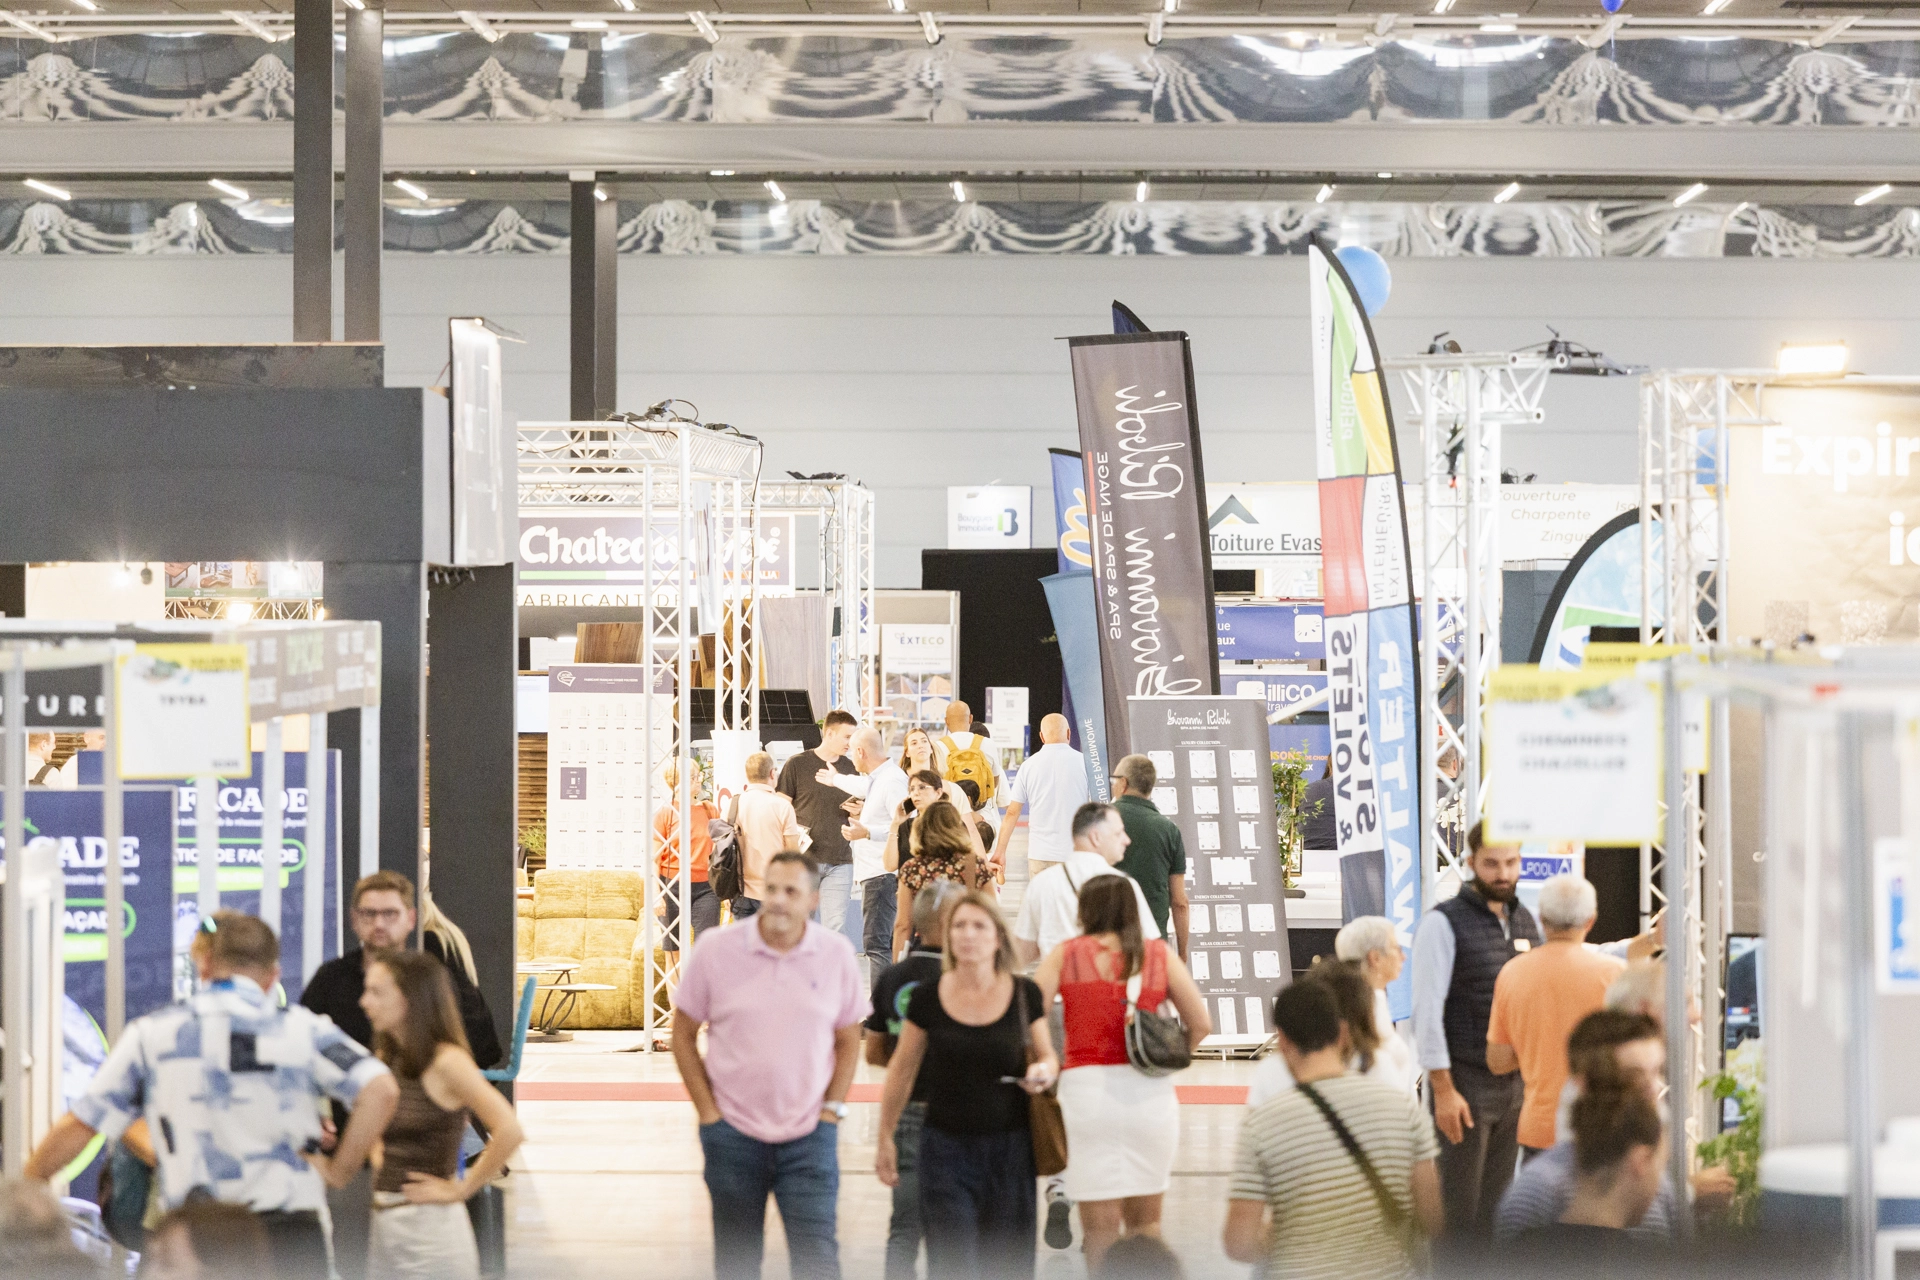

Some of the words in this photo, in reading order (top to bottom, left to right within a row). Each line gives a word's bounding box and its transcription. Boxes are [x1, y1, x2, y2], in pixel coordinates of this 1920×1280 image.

[1500, 490, 1576, 502] ouverture
[1511, 508, 1591, 523] Charpente
[1209, 533, 1274, 552] Toiture
[516, 593, 644, 607] ABRICANT
[1267, 684, 1316, 702] illiCO
